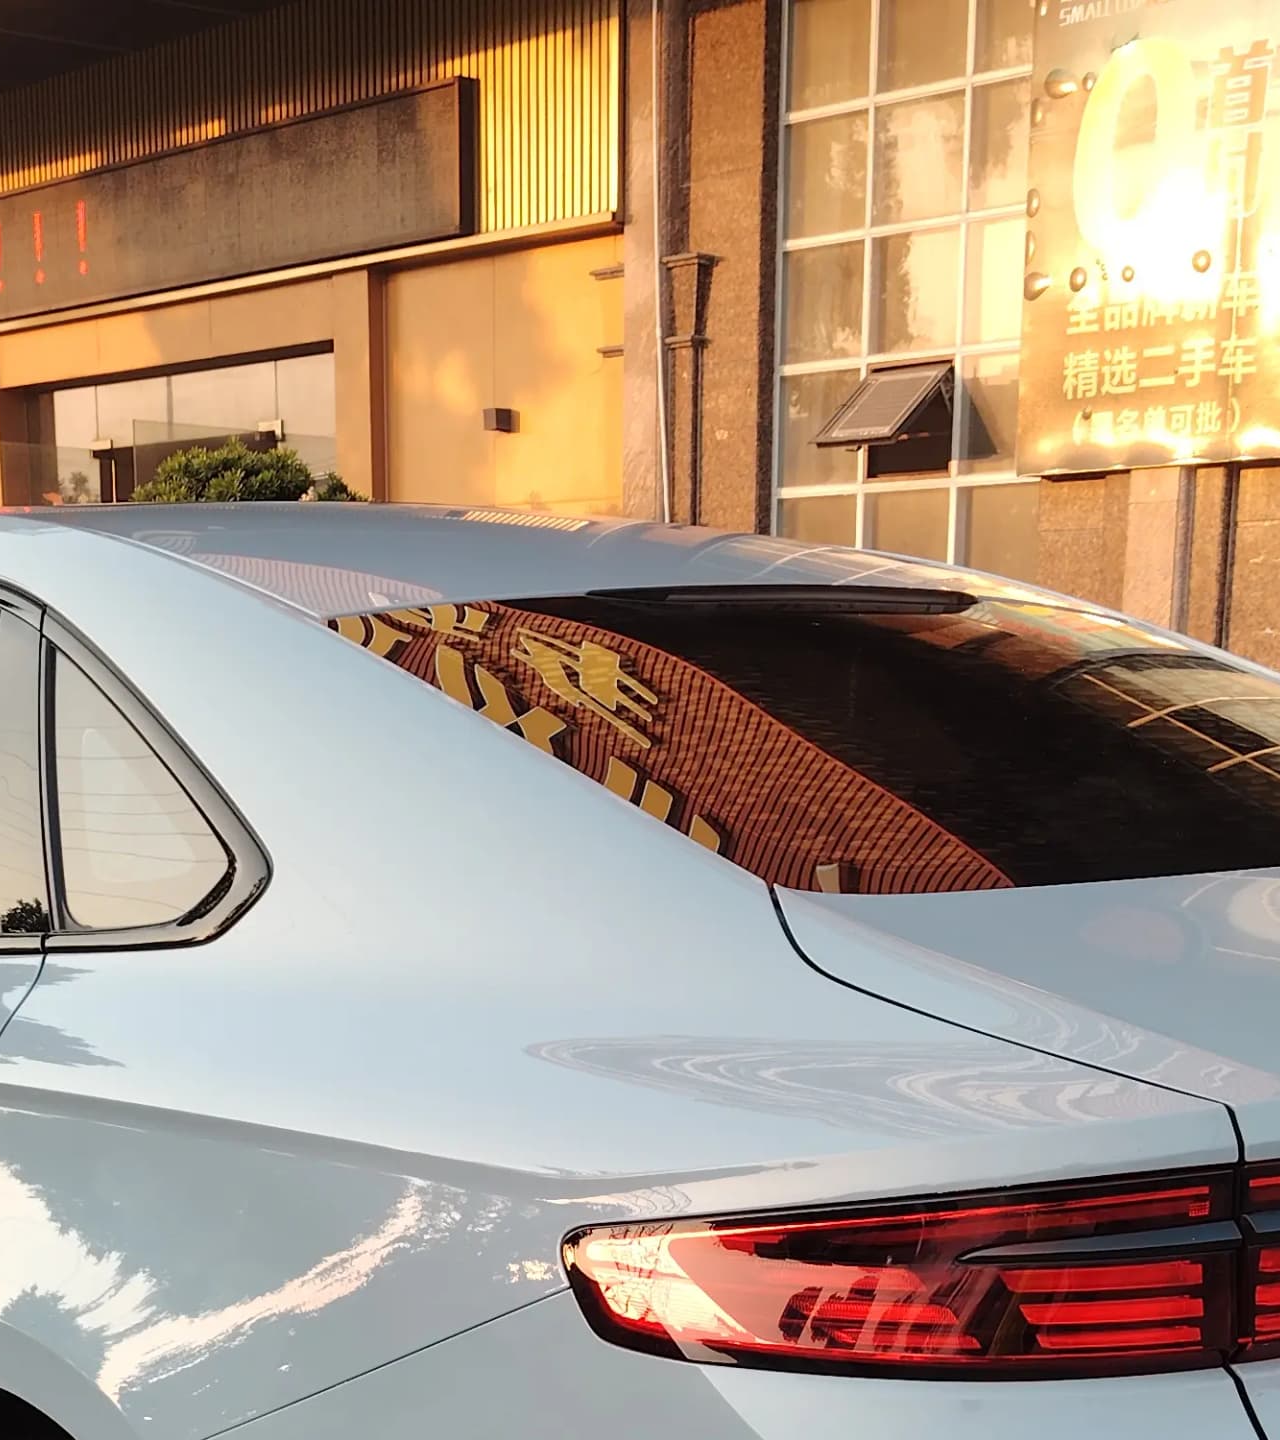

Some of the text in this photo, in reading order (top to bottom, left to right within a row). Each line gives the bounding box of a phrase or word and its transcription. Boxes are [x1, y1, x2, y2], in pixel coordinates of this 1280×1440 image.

[1062, 337, 1257, 400] 精选二手车
